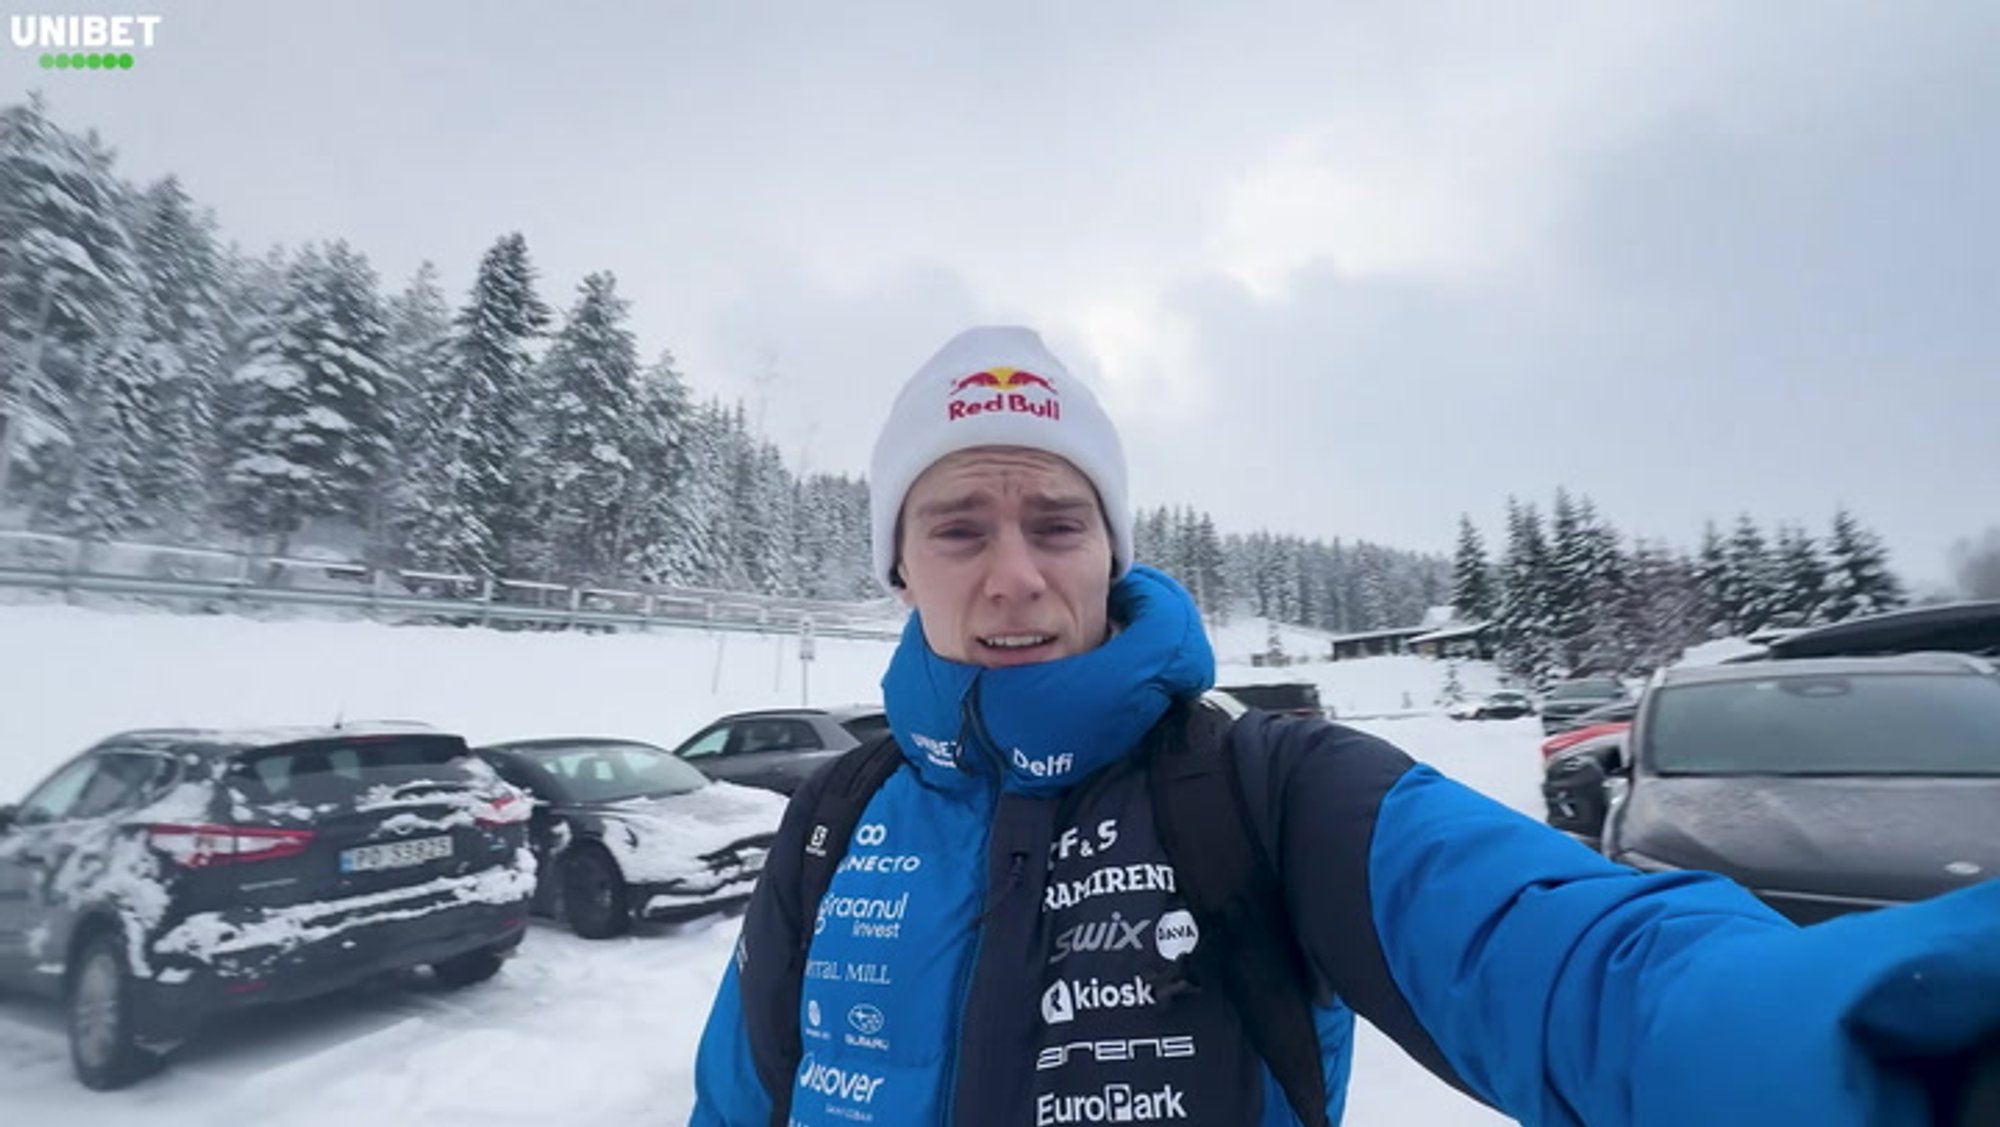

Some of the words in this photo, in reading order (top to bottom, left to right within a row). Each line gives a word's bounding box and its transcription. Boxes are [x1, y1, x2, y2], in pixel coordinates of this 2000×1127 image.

[949, 393, 1002, 421] Red
[1007, 393, 1059, 421] Bull
[1013, 748, 1074, 777] Delfi
[852, 920, 901, 938] invest
[1050, 911, 1152, 963] swix
[1073, 975, 1155, 1010] kiosk
[1036, 1035, 1195, 1071] arens
[1036, 1083, 1187, 1127] EuroPark
